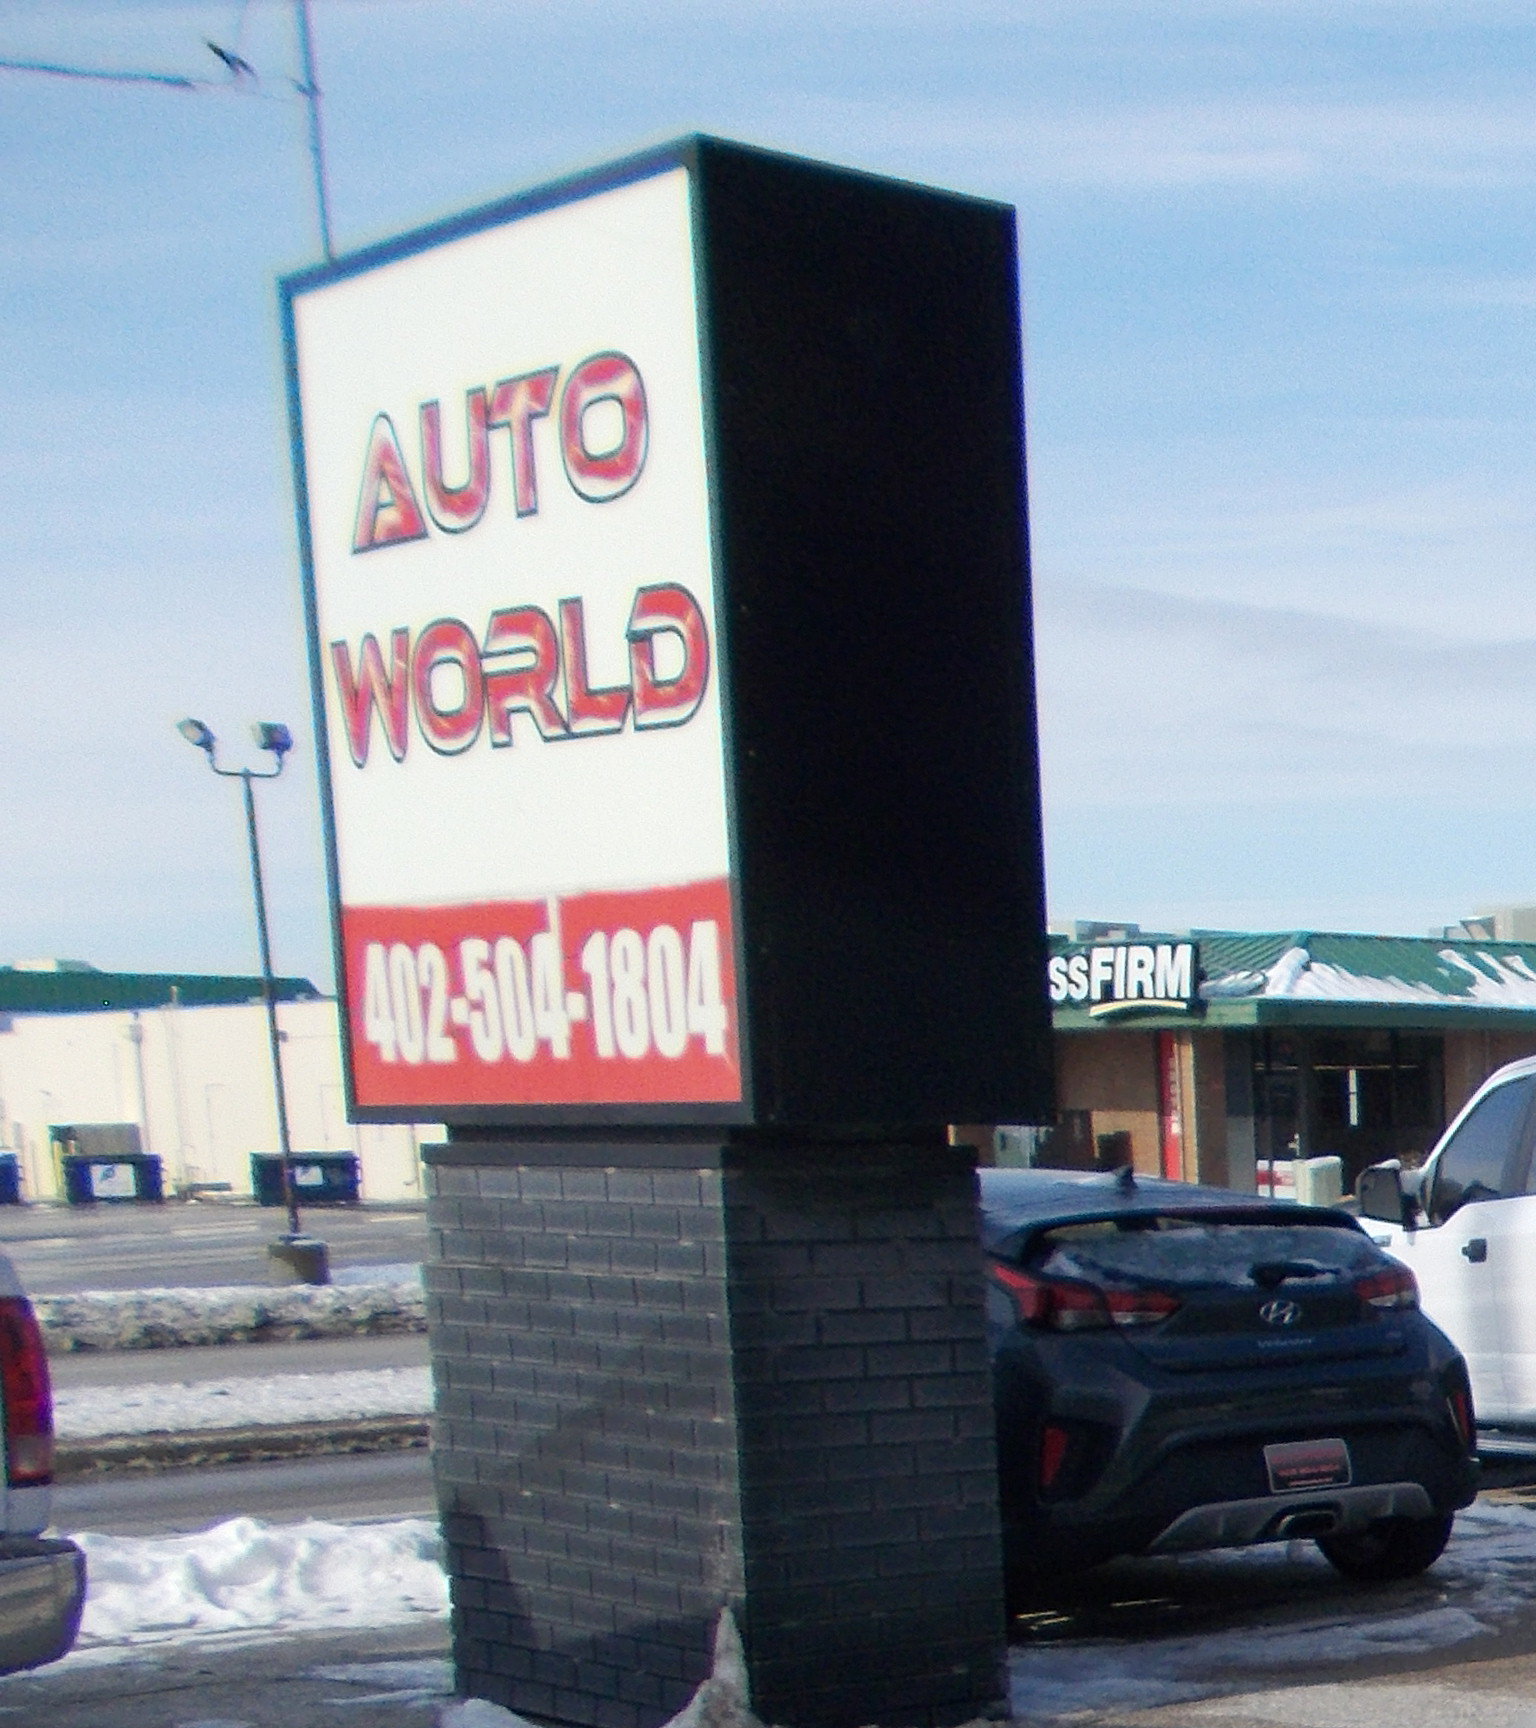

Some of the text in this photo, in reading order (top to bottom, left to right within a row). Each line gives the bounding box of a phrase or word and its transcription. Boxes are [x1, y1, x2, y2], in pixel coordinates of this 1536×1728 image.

[351, 348, 651, 555] AUTO
[331, 581, 711, 769] WORLD
[363, 920, 727, 1066] 402-504-1804
